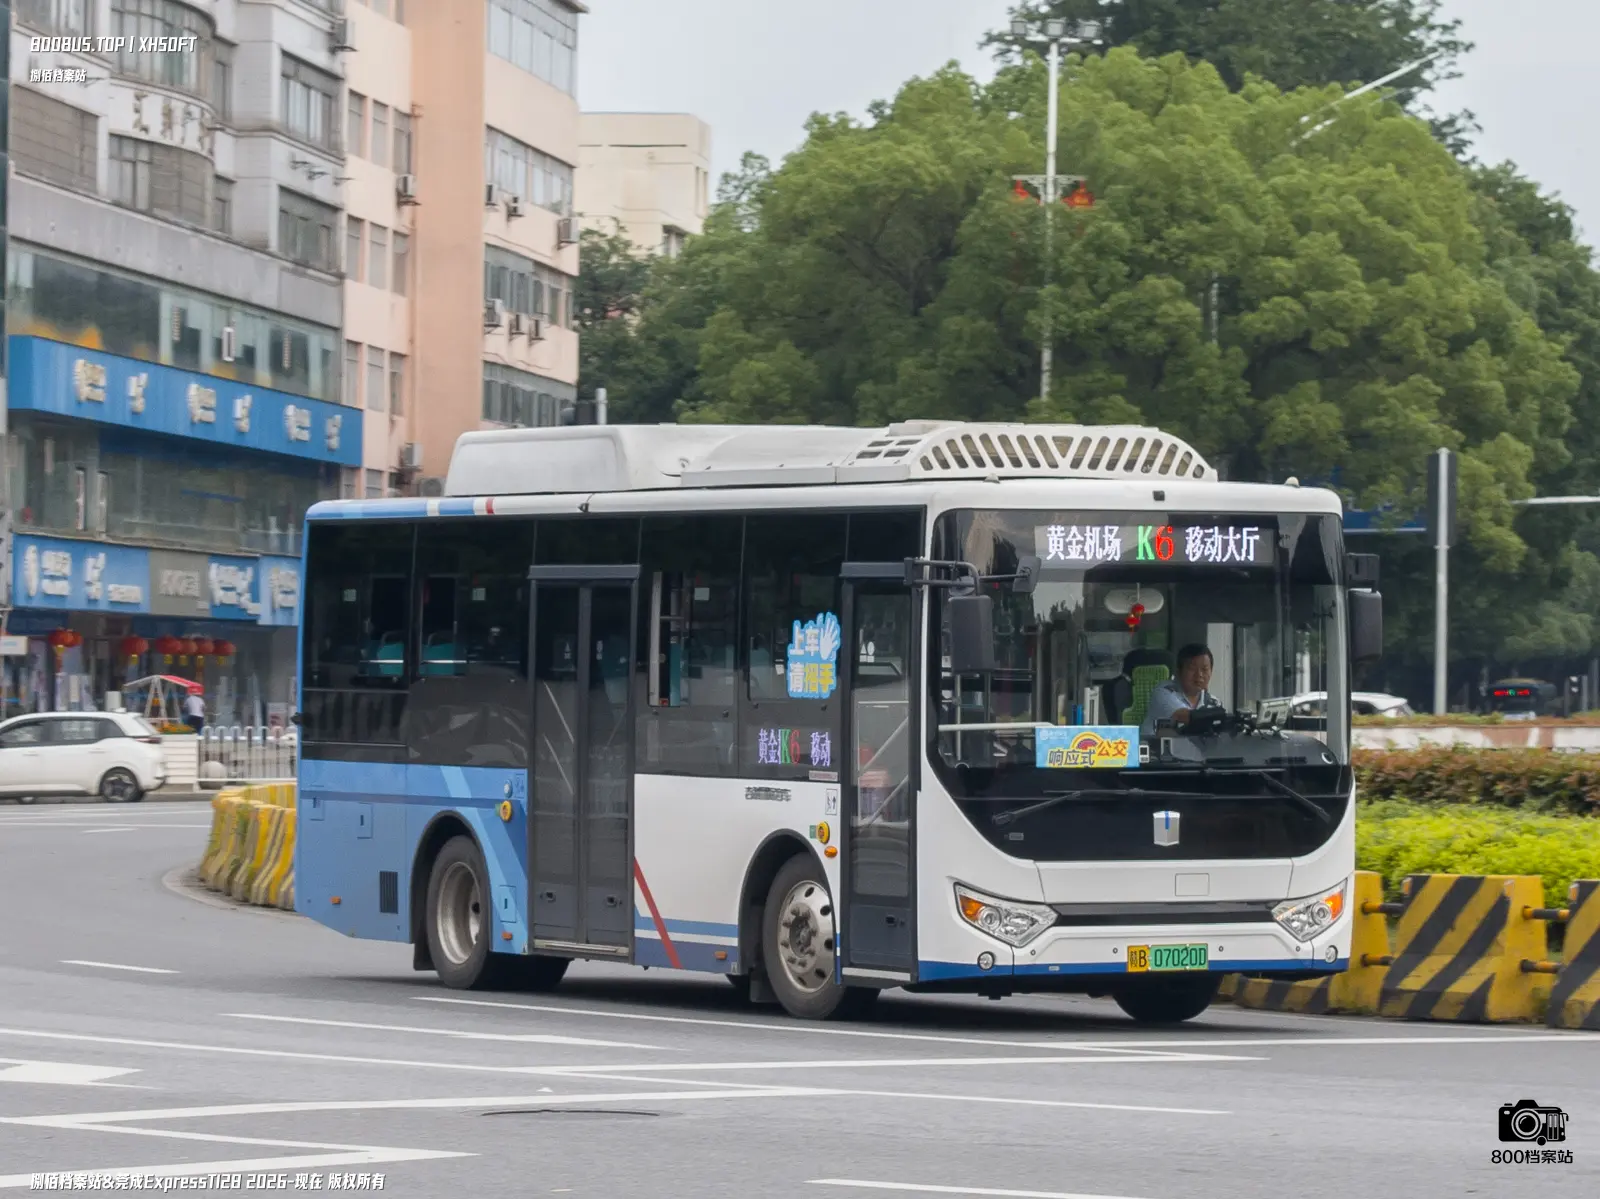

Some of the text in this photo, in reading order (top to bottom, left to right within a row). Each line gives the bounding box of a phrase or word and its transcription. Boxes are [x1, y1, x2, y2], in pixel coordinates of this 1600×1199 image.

[1046, 525, 1260, 562] 黄金机场 K6 移动大厅
[789, 624, 820, 656] 上车
[789, 662, 834, 693] 请招手
[780, 729, 800, 765] K6
[1048, 749, 1096, 766] 响应式
[1097, 740, 1128, 757] 公交
[1154, 947, 1207, 967] 07020D
